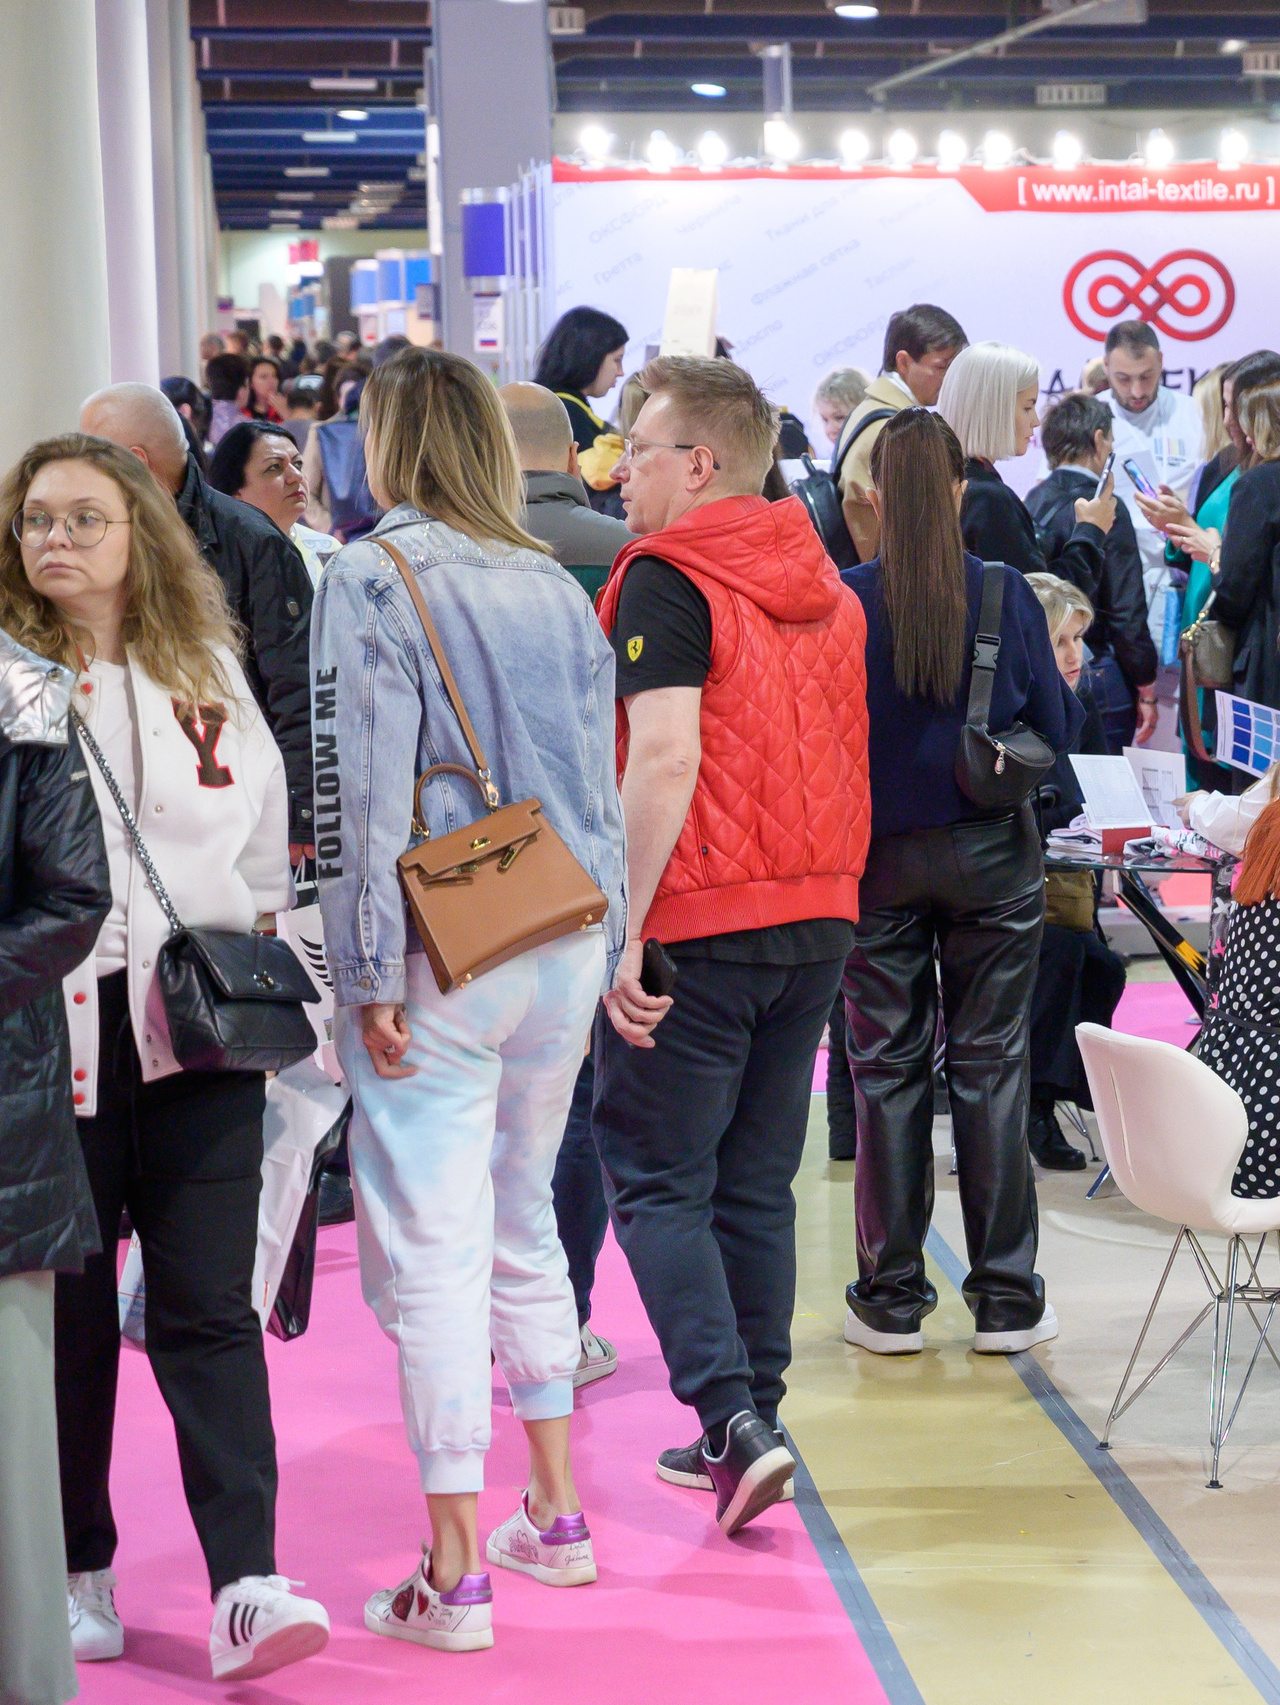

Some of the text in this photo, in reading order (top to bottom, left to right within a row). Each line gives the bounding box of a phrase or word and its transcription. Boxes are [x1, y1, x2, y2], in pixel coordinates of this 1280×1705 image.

[1031, 176, 1261, 202] www.intai-textile.ru
[170, 696, 235, 789] Y
[315, 665, 344, 880] FOLLOW ME
